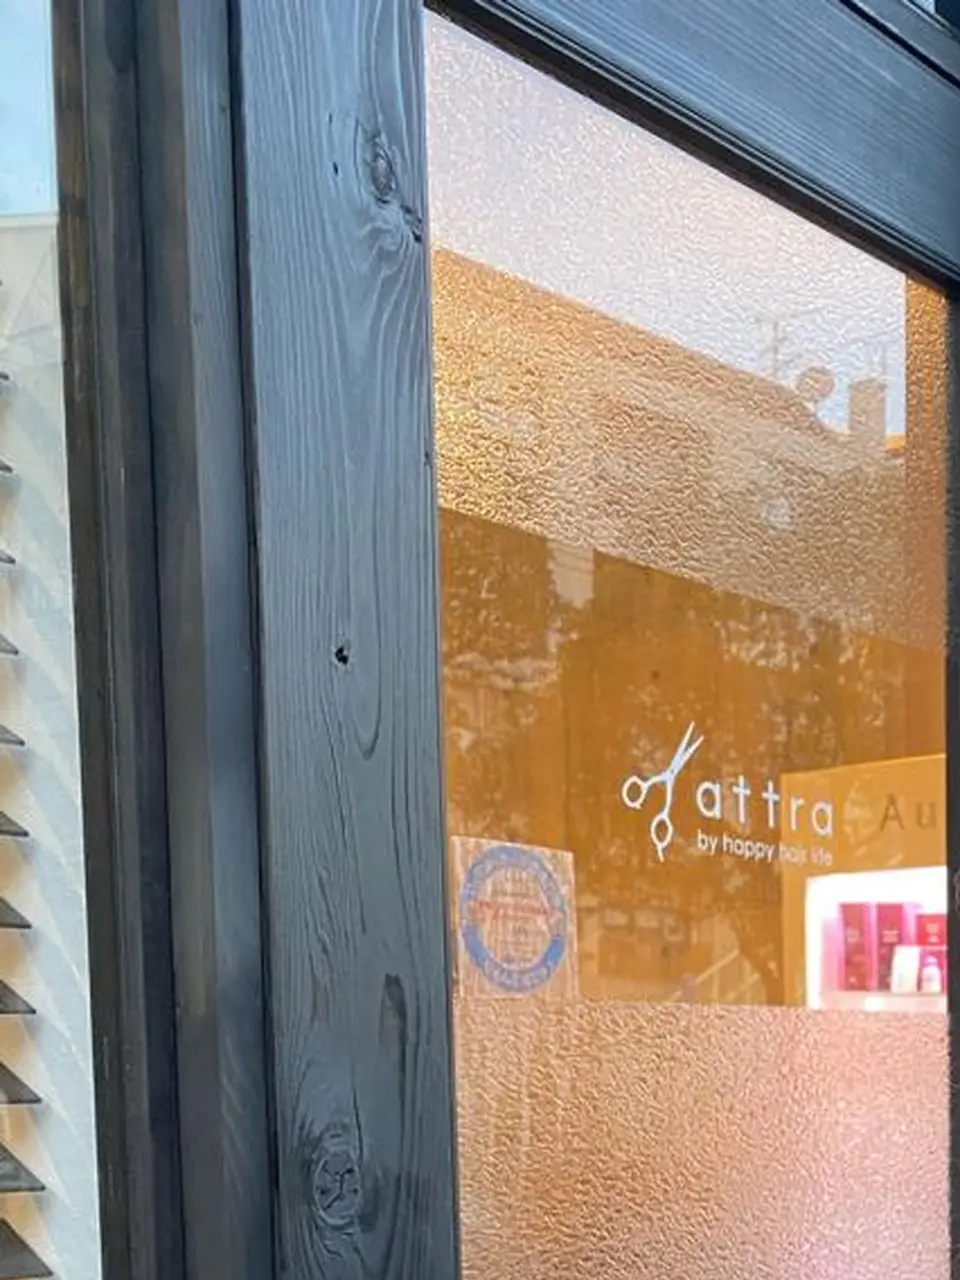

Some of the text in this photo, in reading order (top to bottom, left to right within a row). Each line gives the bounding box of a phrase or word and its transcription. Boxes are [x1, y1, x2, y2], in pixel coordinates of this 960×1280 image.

[695, 774, 833, 837] attra
[697, 829, 719, 855] by
[723, 832, 775, 862] happy
